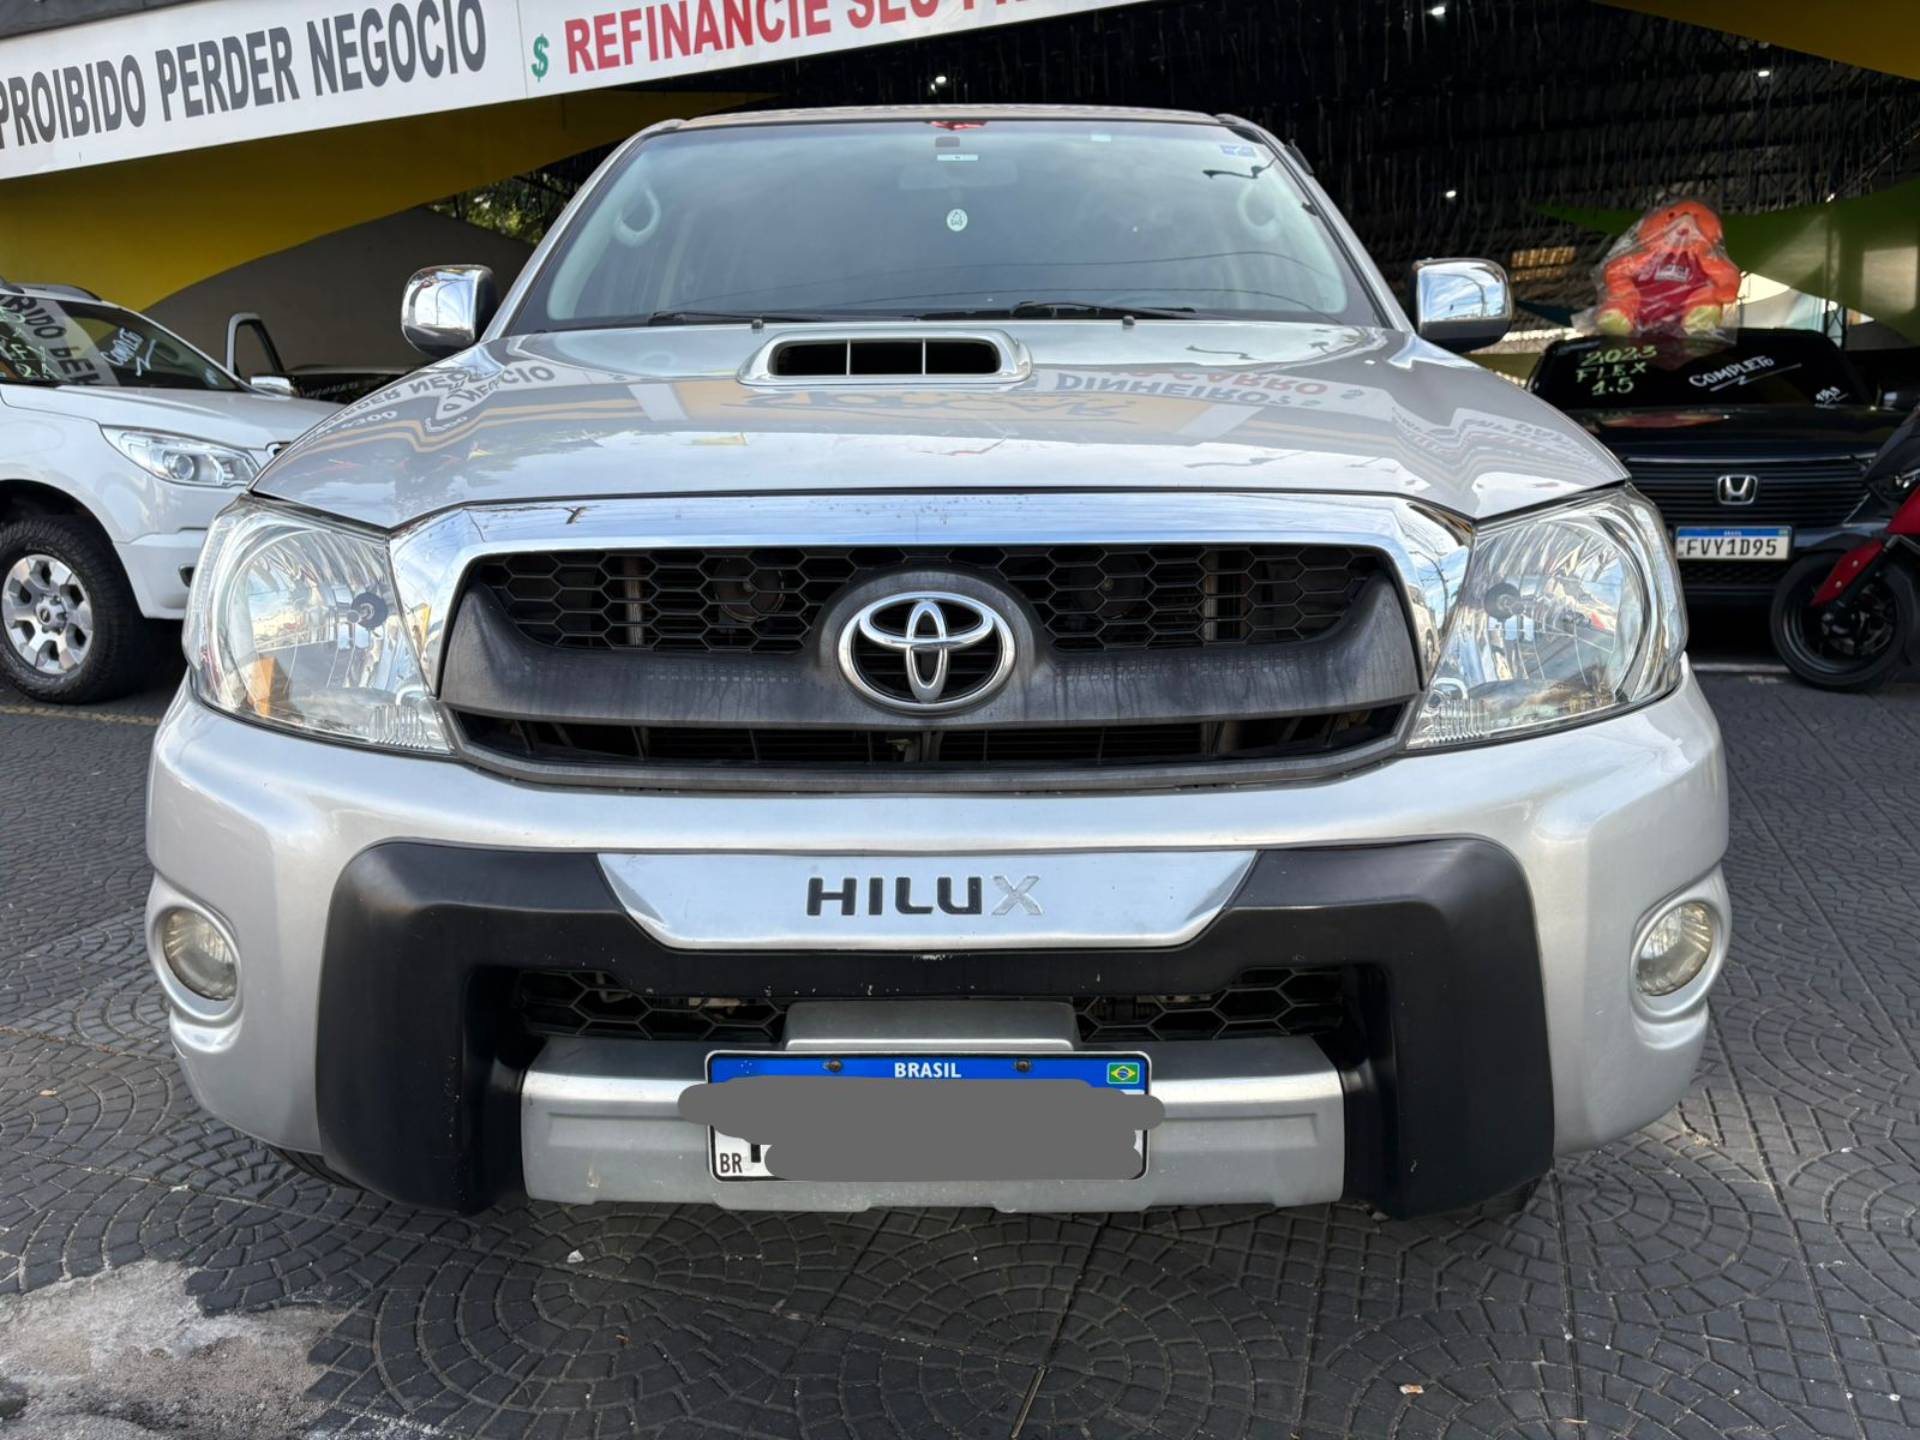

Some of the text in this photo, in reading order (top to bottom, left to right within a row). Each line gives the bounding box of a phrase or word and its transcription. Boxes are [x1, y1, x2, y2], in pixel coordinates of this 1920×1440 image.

[565, 0, 832, 75] REFINANCIE
[155, 26, 300, 122] PERDER
[1580, 345, 1657, 367] 2023
[1575, 361, 1647, 383] FLEX
[1591, 376, 1634, 396] 1.5
[1686, 538, 1778, 556] FVY1D95
[806, 875, 1042, 916] HILUX
[894, 1061, 962, 1079] BRASIL
[719, 1153, 743, 1174] BR
